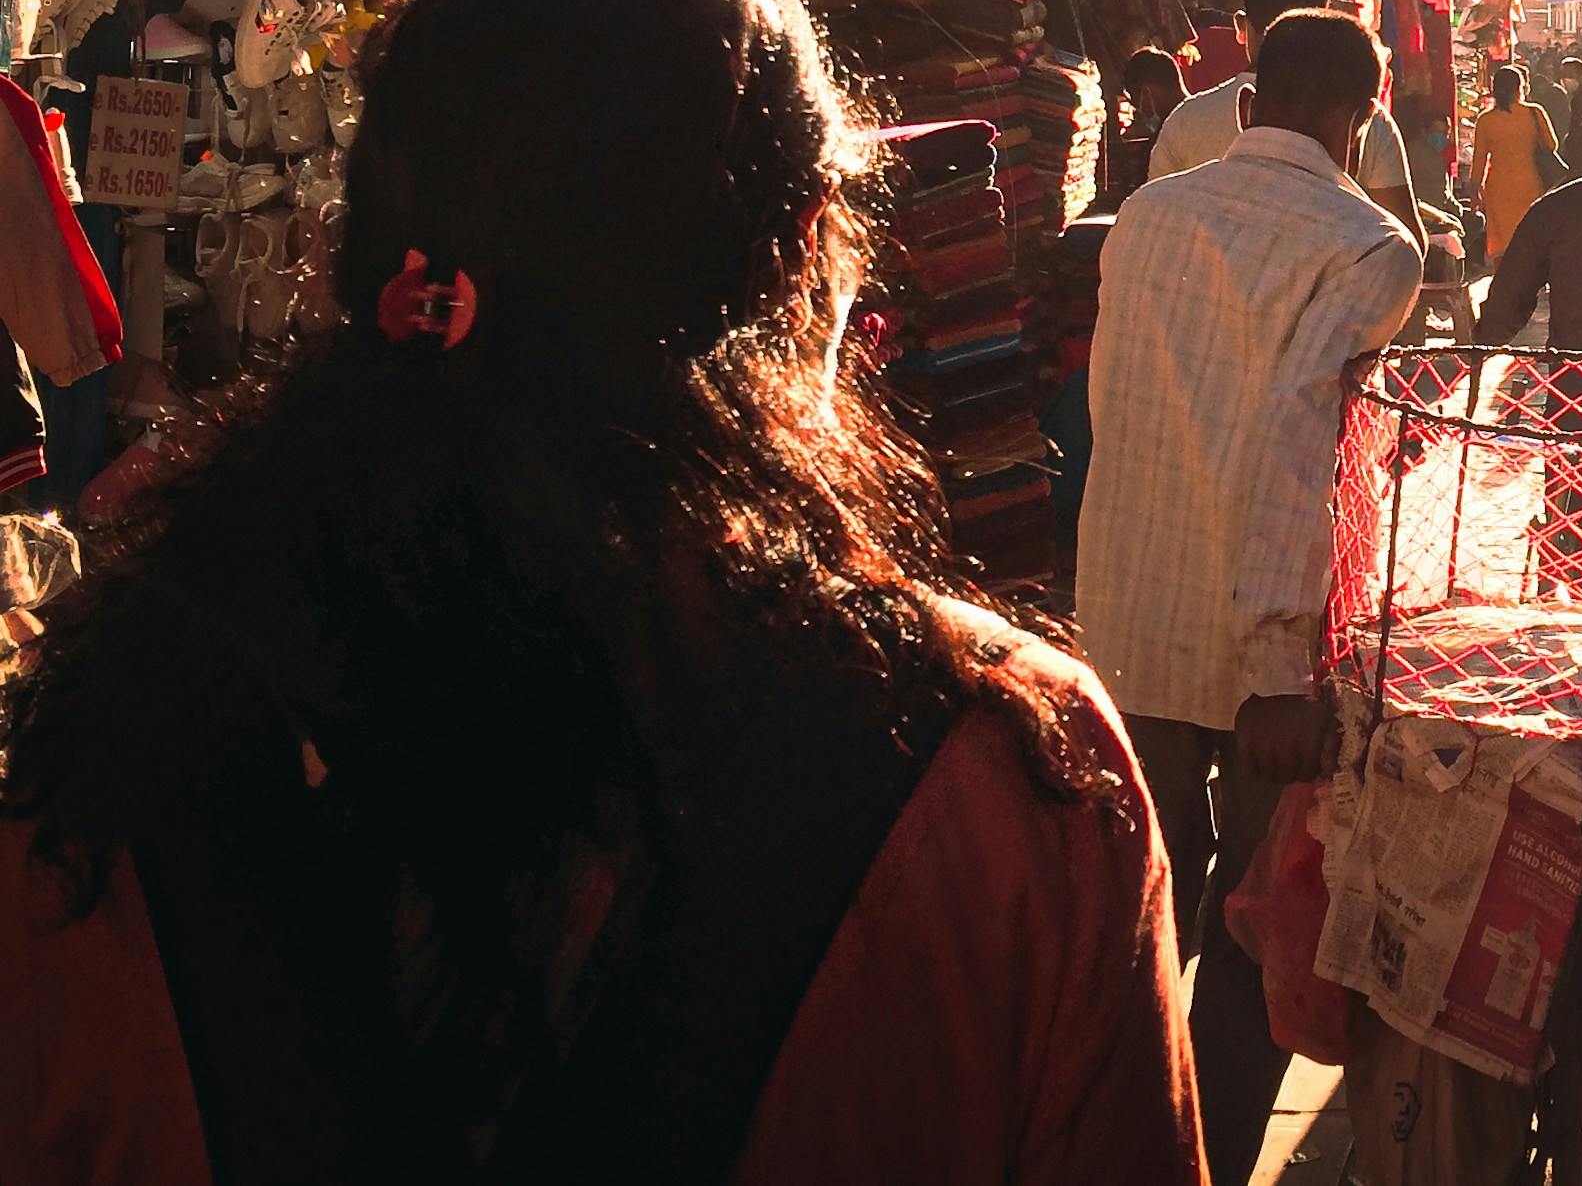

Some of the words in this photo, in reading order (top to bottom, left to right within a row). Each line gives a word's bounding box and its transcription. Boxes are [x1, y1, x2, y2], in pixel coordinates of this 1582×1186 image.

[107, 85, 180, 119] Rs.2650/-
[102, 125, 176, 159] Rs.2150/-
[97, 166, 173, 198] Rs.1650/-
[1512, 830, 1535, 849] USE
[1507, 845, 1540, 868] HAND
